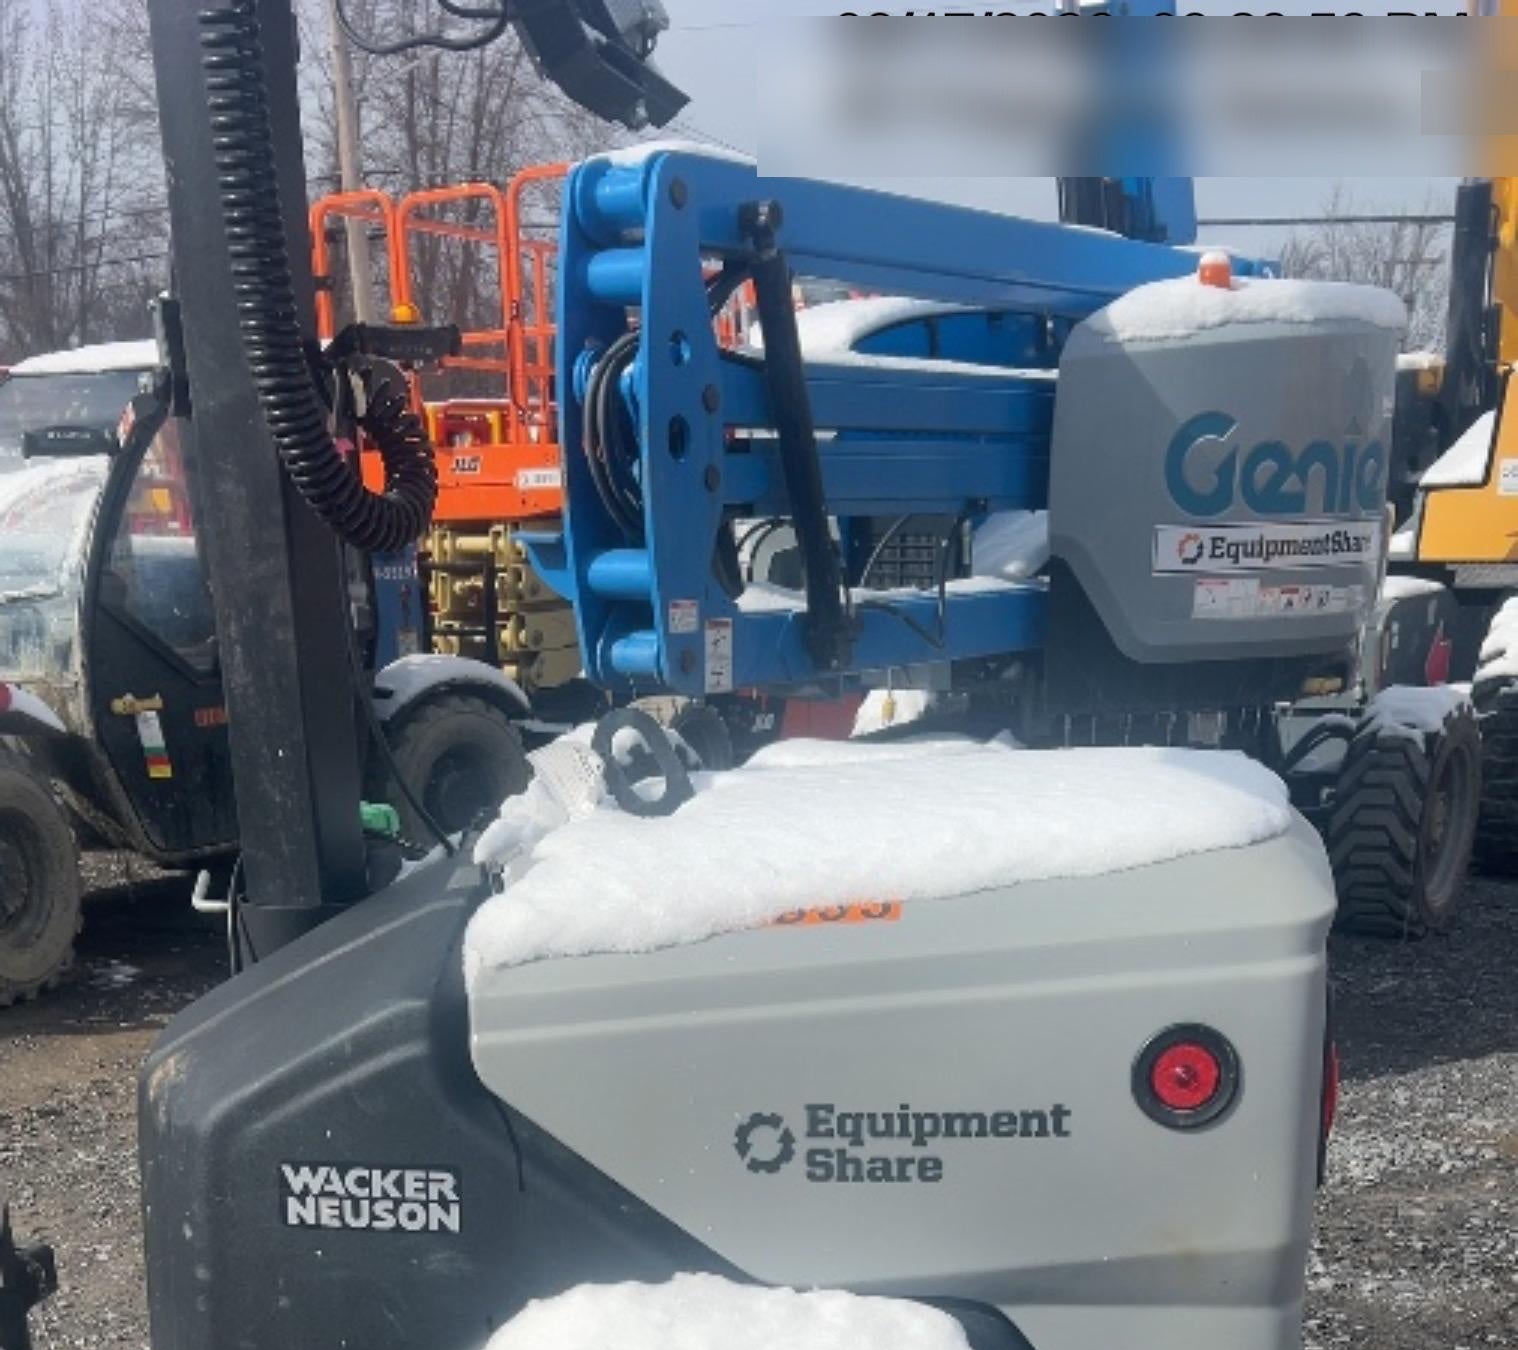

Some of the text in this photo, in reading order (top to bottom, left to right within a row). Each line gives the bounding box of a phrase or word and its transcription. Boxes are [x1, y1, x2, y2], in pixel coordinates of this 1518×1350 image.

[1164, 411, 1385, 517] Genie
[804, 1103, 1072, 1147] Equipment
[280, 1164, 460, 1201] WACKER
[805, 1148, 943, 1183] Share
[286, 1195, 460, 1234] NEUSON
